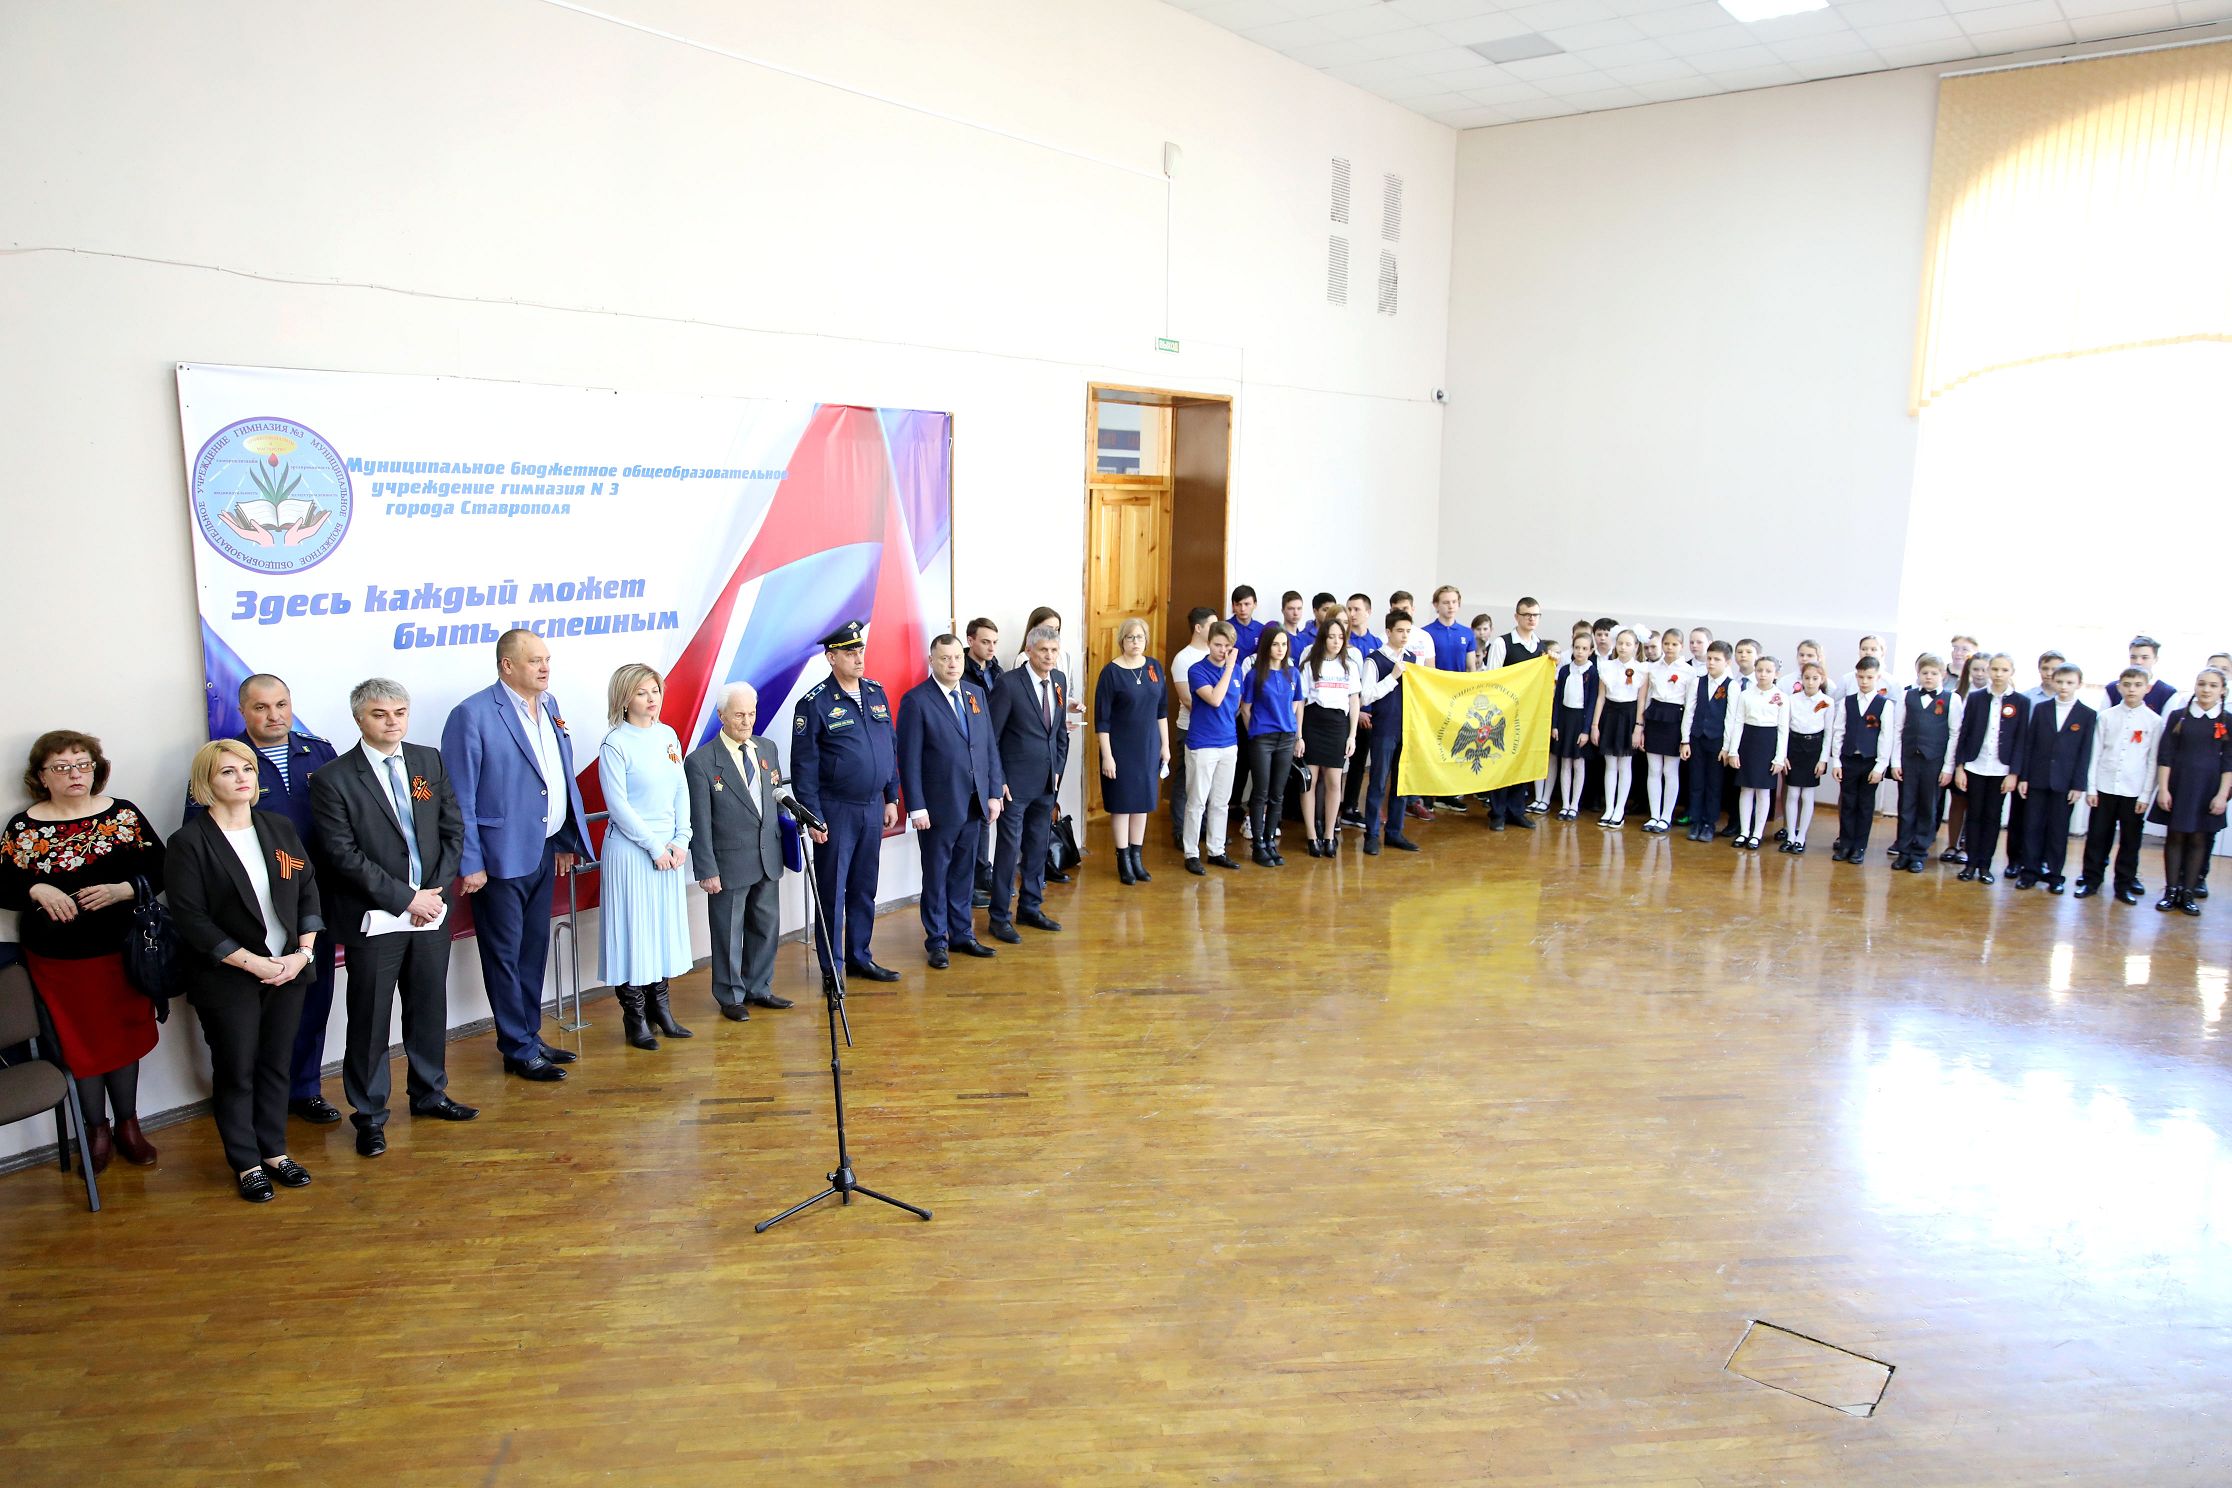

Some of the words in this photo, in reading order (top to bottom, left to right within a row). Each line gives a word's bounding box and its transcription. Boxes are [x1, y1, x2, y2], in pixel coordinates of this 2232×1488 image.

[233, 423, 288, 438] ГИМНАЗИЯ
[289, 428, 305, 438] №3
[197, 435, 231, 494] УЧРЕЖДЕНИЕ
[310, 438, 348, 518] МУНИЦИПАЛЬНОЕ
[345, 457, 505, 476] Муниципальное
[511, 461, 617, 478] бюджетное
[622, 464, 789, 481] общеобразовательное
[371, 479, 495, 497] учреждение
[500, 483, 585, 497] гимназия
[609, 482, 620, 496] 3
[385, 502, 455, 518] города
[460, 500, 571, 518] Ставрополя
[198, 501, 294, 570] ОБЩЕОБРАЗОВАТЕЛЬНОЕ
[299, 521, 344, 565] БЮДЖЕТНОЕ
[231, 590, 352, 625] Здесь
[364, 578, 519, 614] каждый
[528, 575, 647, 604] может
[393, 621, 500, 650] быть
